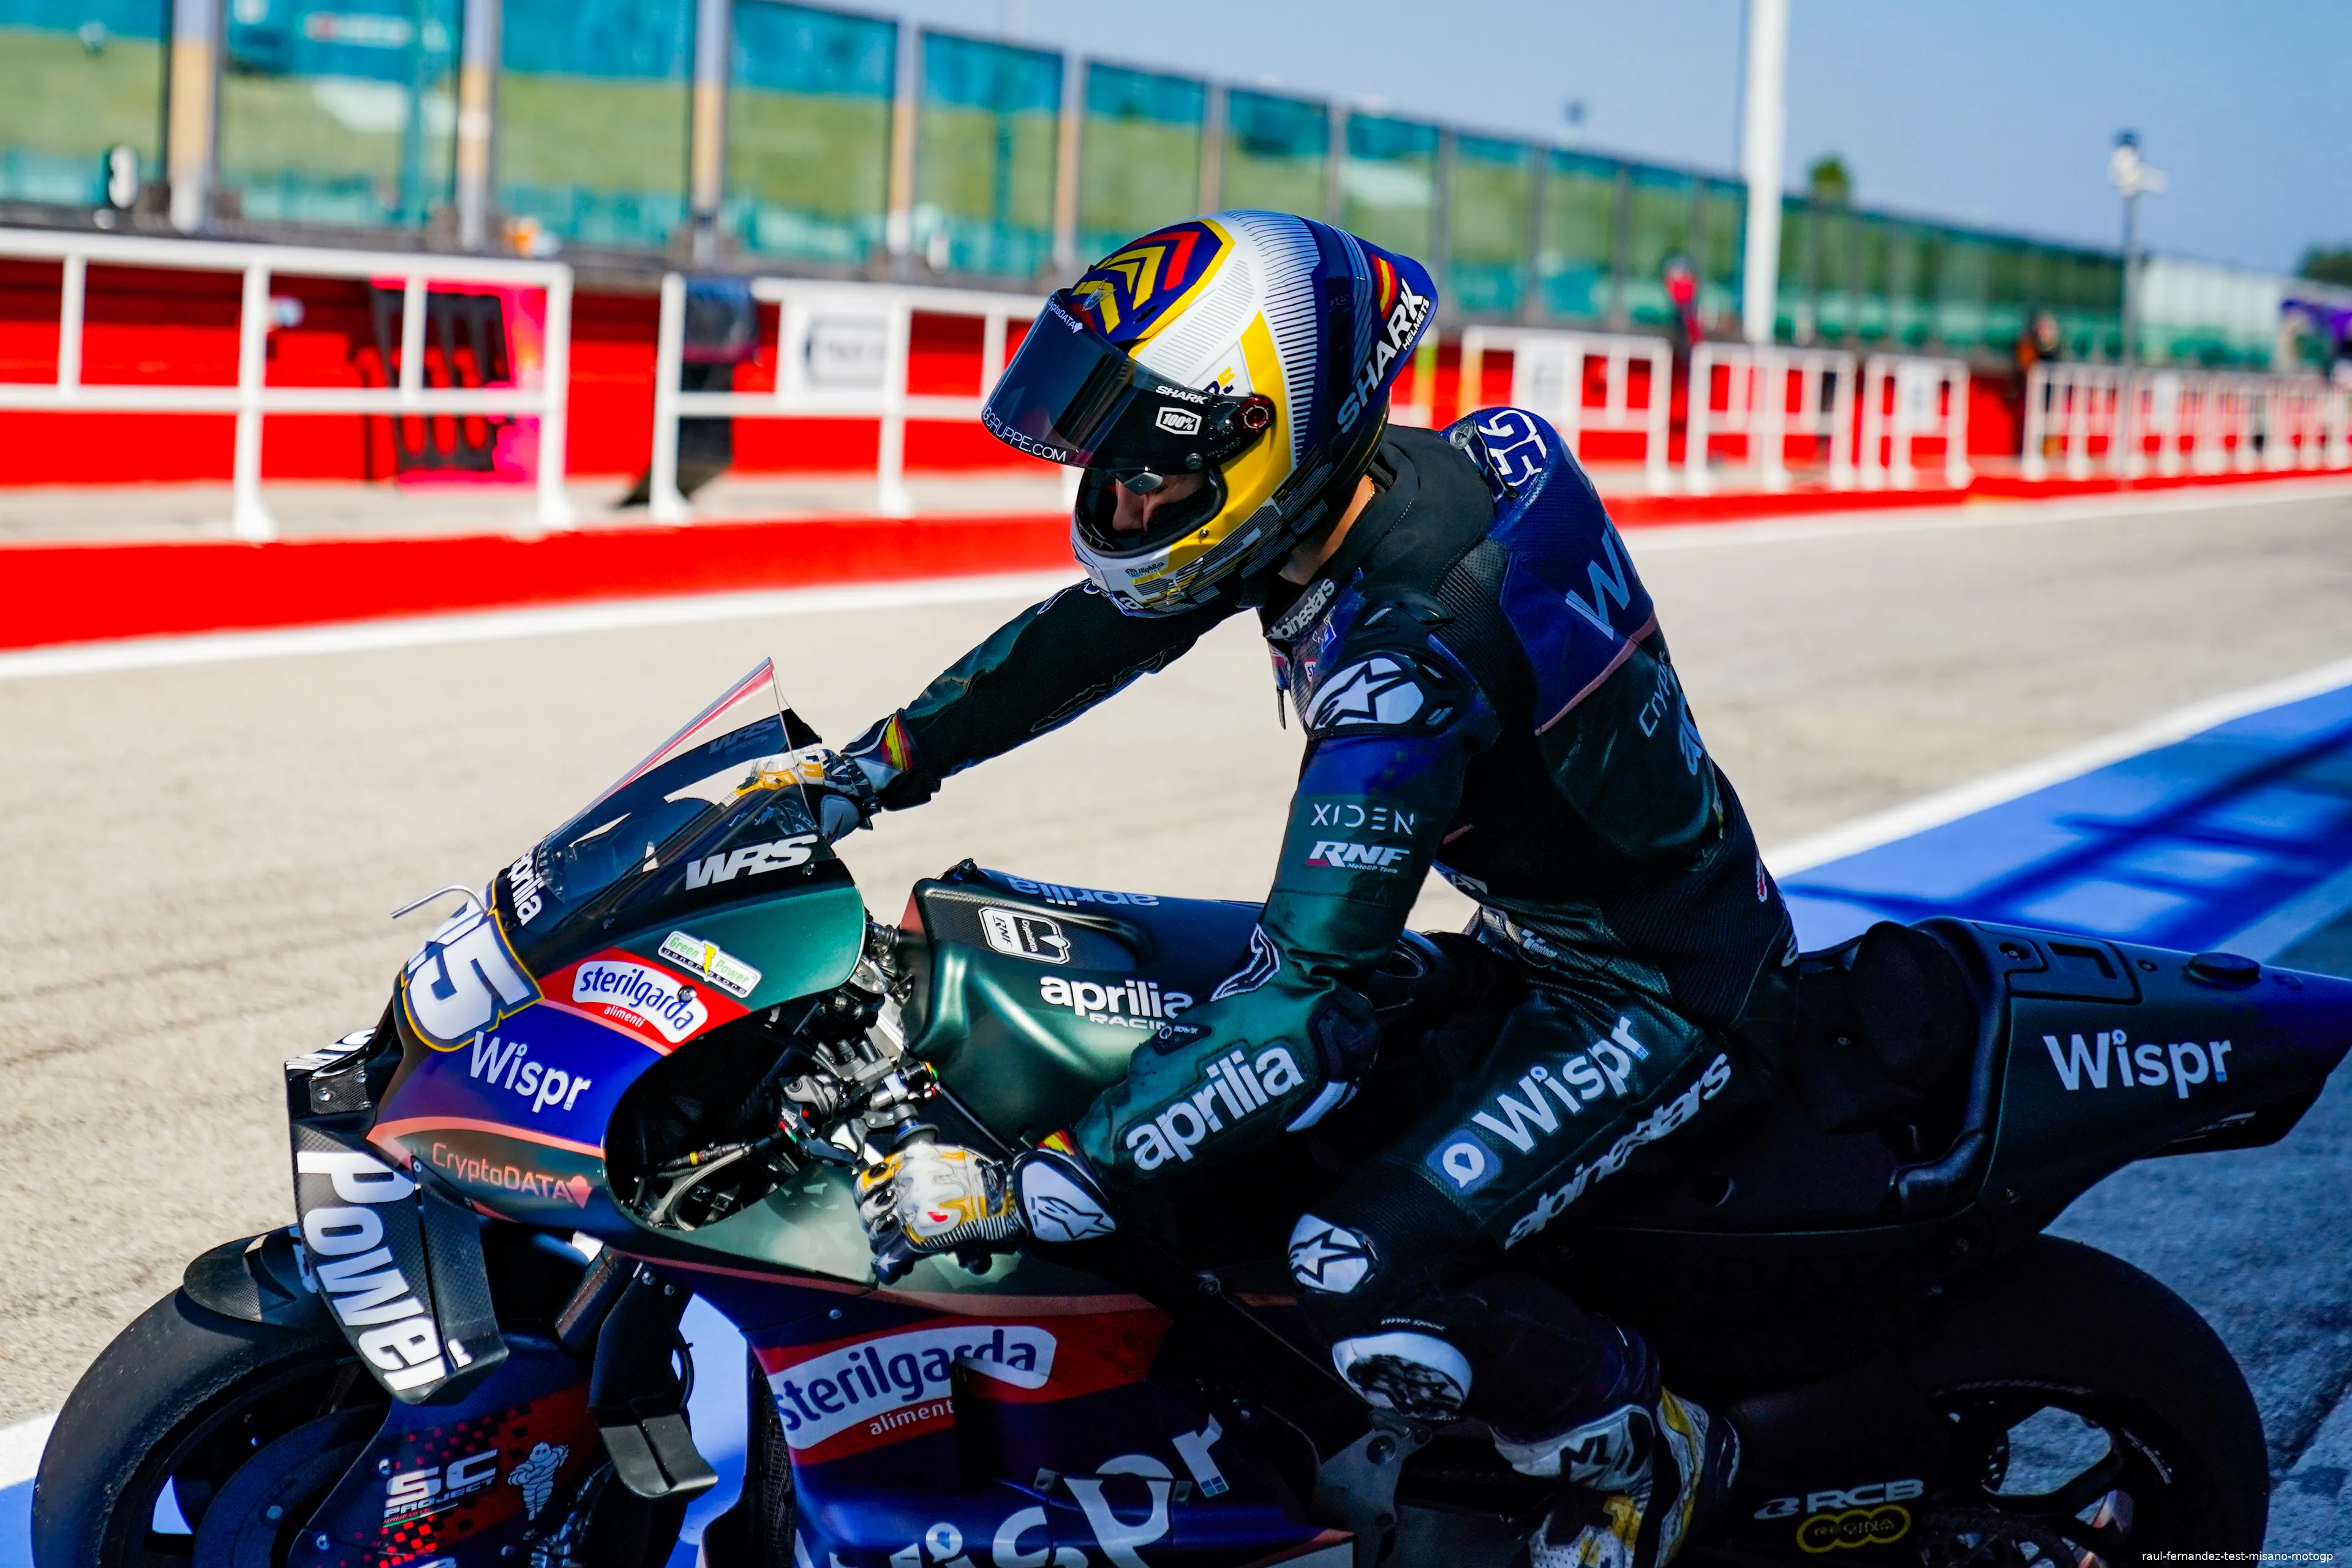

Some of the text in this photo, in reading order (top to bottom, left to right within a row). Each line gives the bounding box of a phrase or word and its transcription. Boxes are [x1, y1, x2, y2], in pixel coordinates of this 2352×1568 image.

[1048, 298, 1076, 330] CryptoDATA
[1402, 298, 1430, 351] HELMETS
[1337, 277, 1423, 434] SHARK
[1155, 384, 1209, 405] SHARK
[1163, 413, 1196, 431] 100%
[1311, 804, 1414, 835] XIDEN
[685, 834, 818, 891] WRS
[1309, 841, 1410, 867] RNF
[1006, 876, 1159, 907] aprilia
[669, 937, 750, 984] Green Power
[579, 967, 694, 1031] sterilgarda
[603, 1005, 646, 1028] alimenti
[470, 1030, 592, 1114] Wispr
[1471, 1016, 1651, 1155] Wispr
[2042, 1029, 2233, 1099] Wispr
[1126, 1046, 1305, 1172] aprilia
[432, 1142, 575, 1204] CryptoDATA
[296, 1151, 473, 1392] Power
[869, 1399, 954, 1436] aliment
[383, 1476, 496, 1518] PROJECT
[385, 1449, 498, 1508] SC
[1806, 1477, 1924, 1514] RCB
